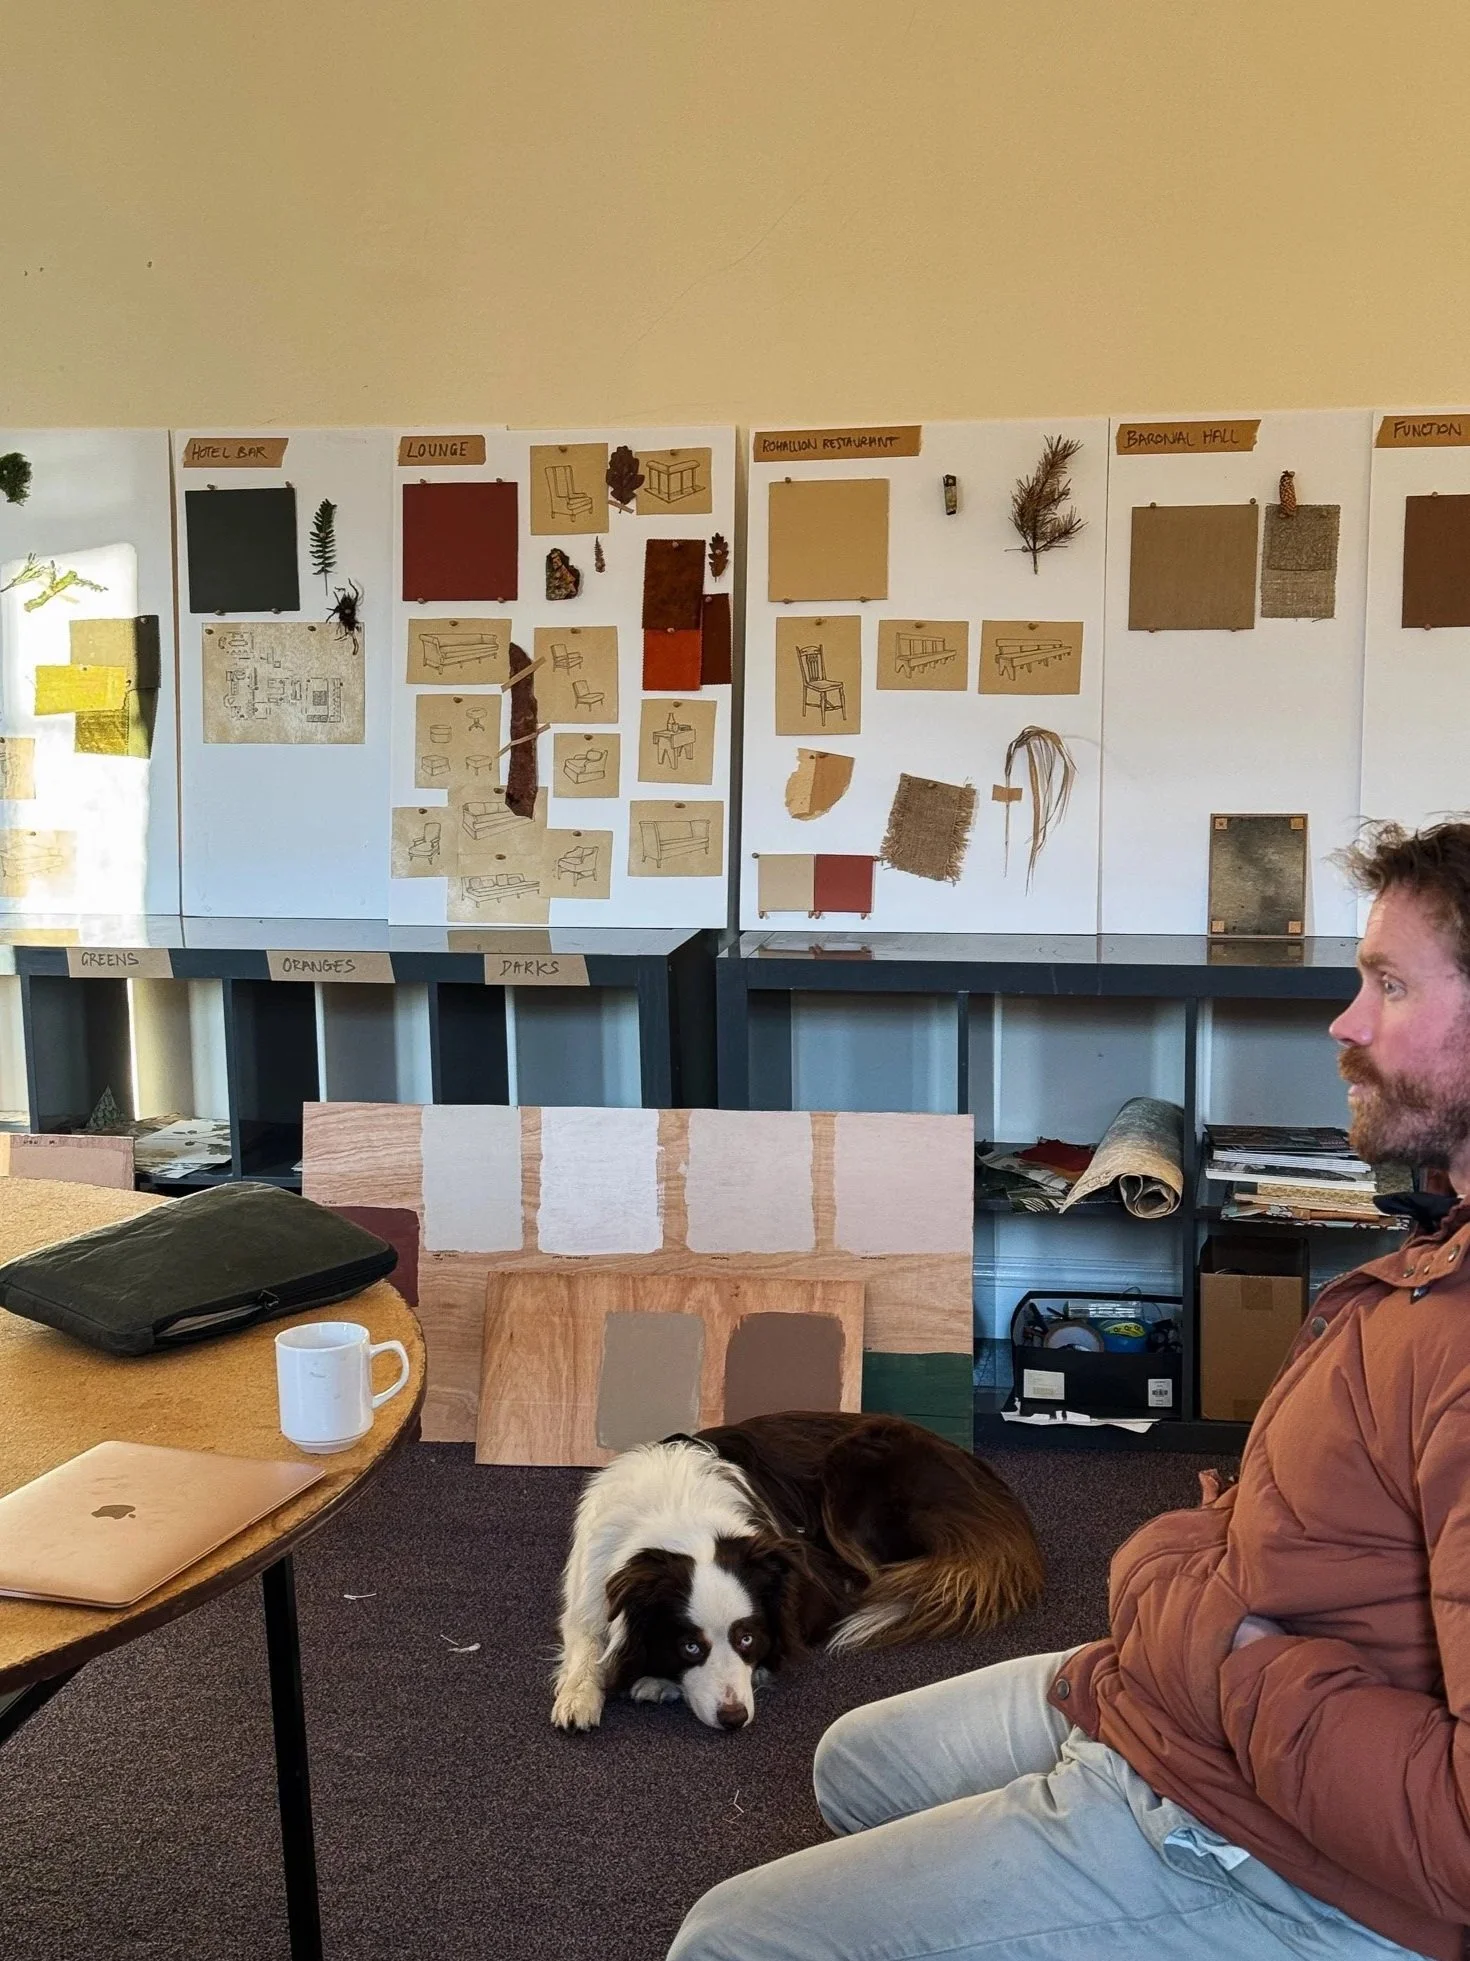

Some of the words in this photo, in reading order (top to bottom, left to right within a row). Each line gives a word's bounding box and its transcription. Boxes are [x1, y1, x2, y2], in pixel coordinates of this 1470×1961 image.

[1393, 420, 1462, 438] FUNCTION
[822, 436, 899, 450] RESTAURANT
[1123, 429, 1195, 449] BARONIAL
[1202, 428, 1239, 444] HALL
[191, 443, 231, 461] HOTEL
[235, 446, 268, 459] BAR
[406, 441, 469, 458] LOUNGE
[81, 951, 140, 967] GREENS
[282, 957, 356, 974] ORANGES
[499, 959, 560, 977] DARKS
